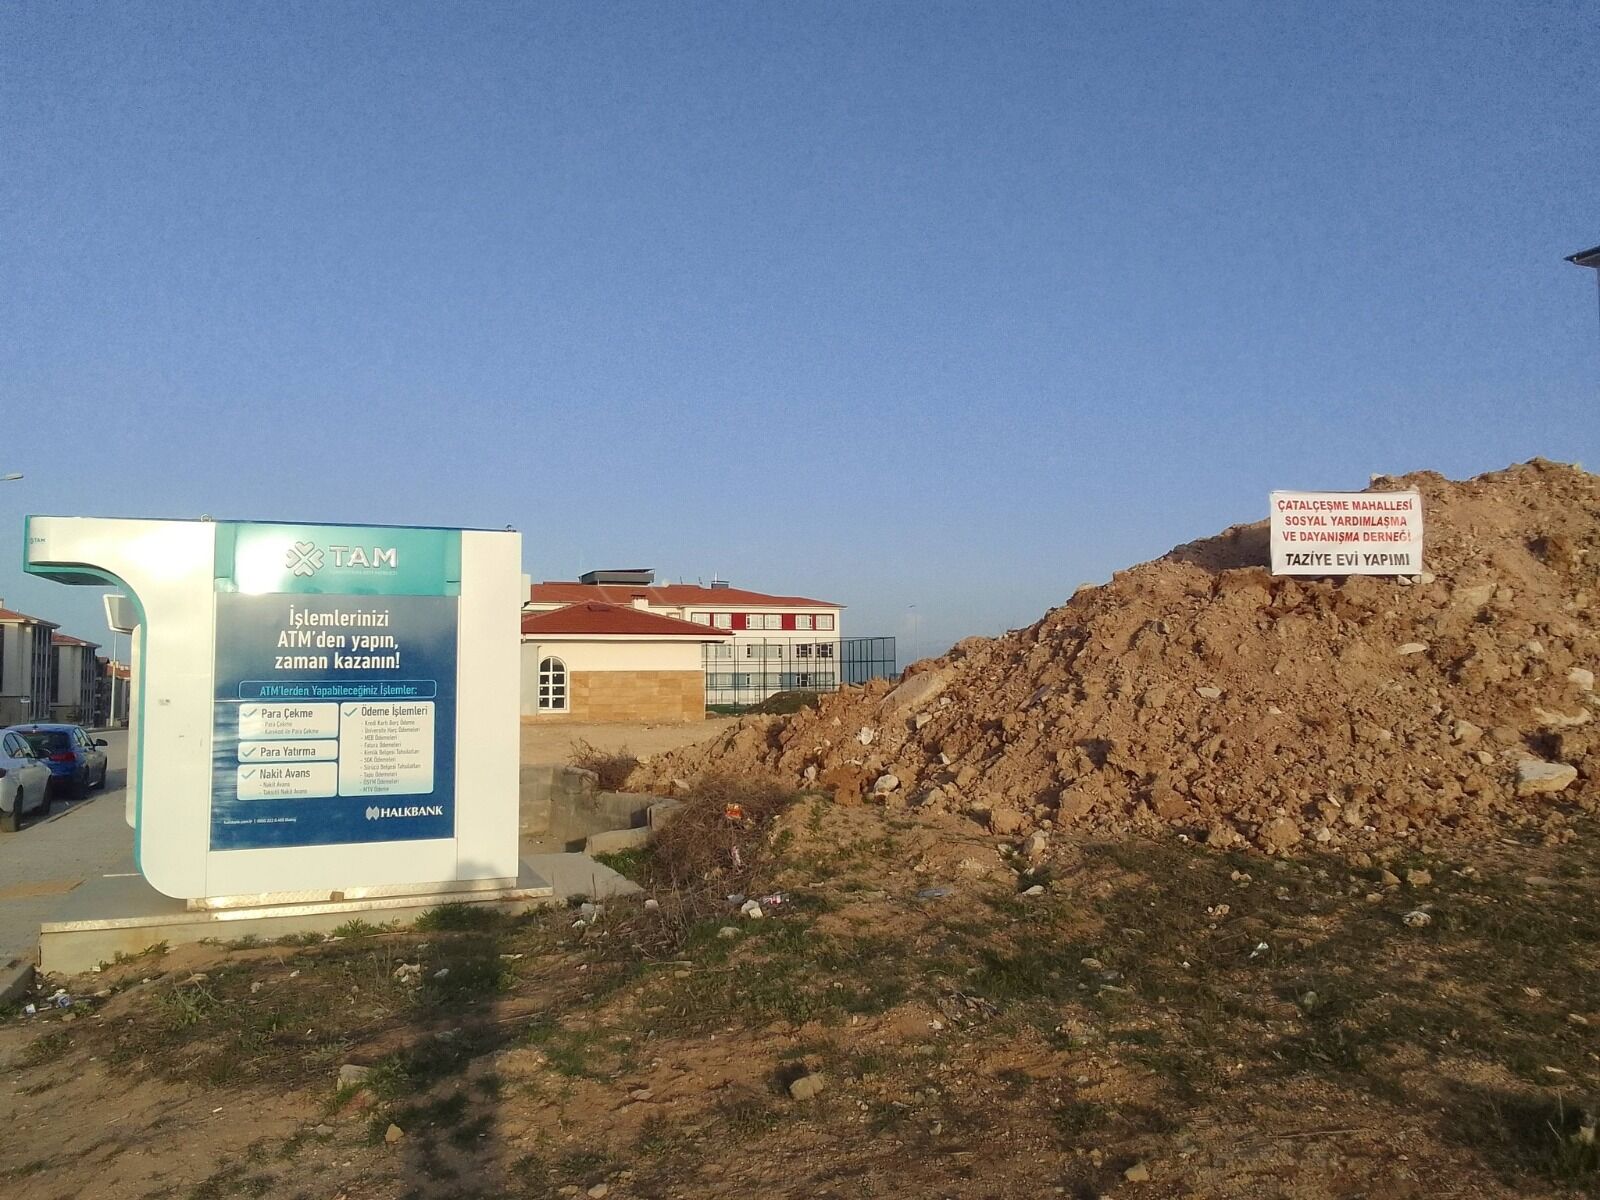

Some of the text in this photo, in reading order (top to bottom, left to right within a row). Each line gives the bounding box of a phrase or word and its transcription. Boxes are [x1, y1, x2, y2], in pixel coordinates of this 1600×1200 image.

[1278, 499, 1412, 513] ÇATALÇEŞME MAHALLESİ
[1285, 516, 1407, 528] SOSYAL YARDIMLAŞMA
[1283, 532, 1296, 541] VE
[1300, 532, 1359, 544] DAYANIŞMA
[329, 545, 398, 568] TAM
[1286, 551, 1409, 566] TAZİYE EVİ YAPIMI
[289, 604, 389, 629] İşlemlerinizi
[278, 631, 398, 651] ATM'den yapın,
[275, 652, 400, 669] zaman kazanın!
[260, 683, 417, 697] ATM'lerden Yapabileceğiniz İşlemler:
[262, 708, 313, 719] Para Çekme
[362, 704, 428, 717] Ödeme İşlemleri
[261, 747, 315, 756] Para Yatırma
[260, 769, 310, 779] Nakit Avans
[381, 805, 443, 818] HALKBANK
